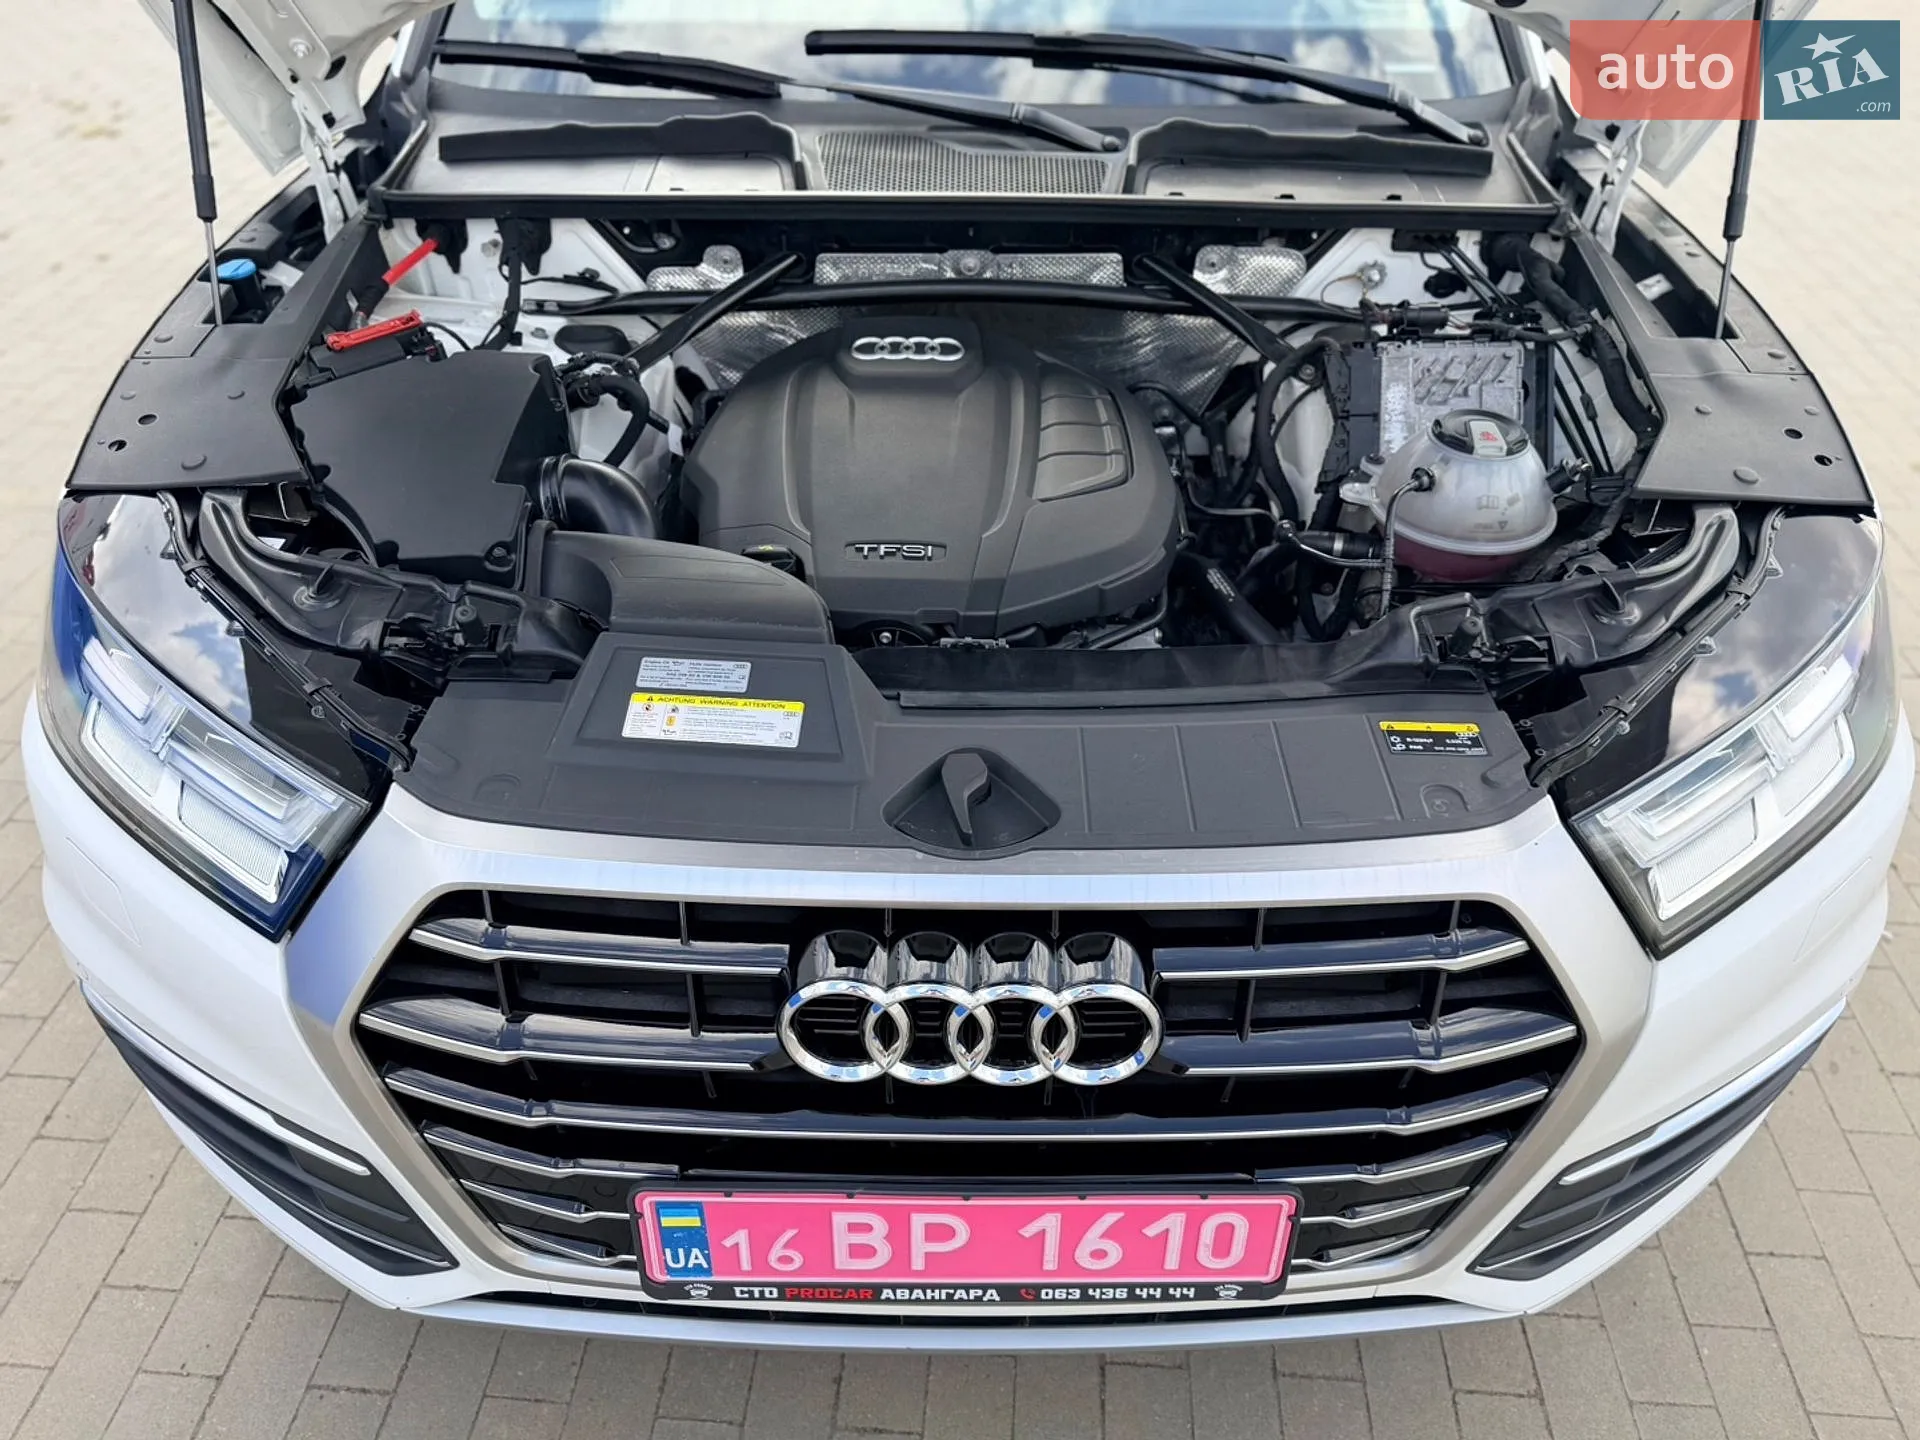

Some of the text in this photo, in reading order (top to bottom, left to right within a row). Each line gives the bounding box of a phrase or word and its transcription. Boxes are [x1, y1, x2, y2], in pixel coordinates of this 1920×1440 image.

[855, 544, 932, 560] TFSI
[721, 1229, 804, 1272] 16
[1018, 1211, 1250, 1271] 1610
[665, 1248, 708, 1269] UA
[785, 1287, 874, 1300] PROCAR
[880, 1288, 1001, 1301] АВАНГАРД
[1041, 1287, 1195, 1300] 063 436 44 44
